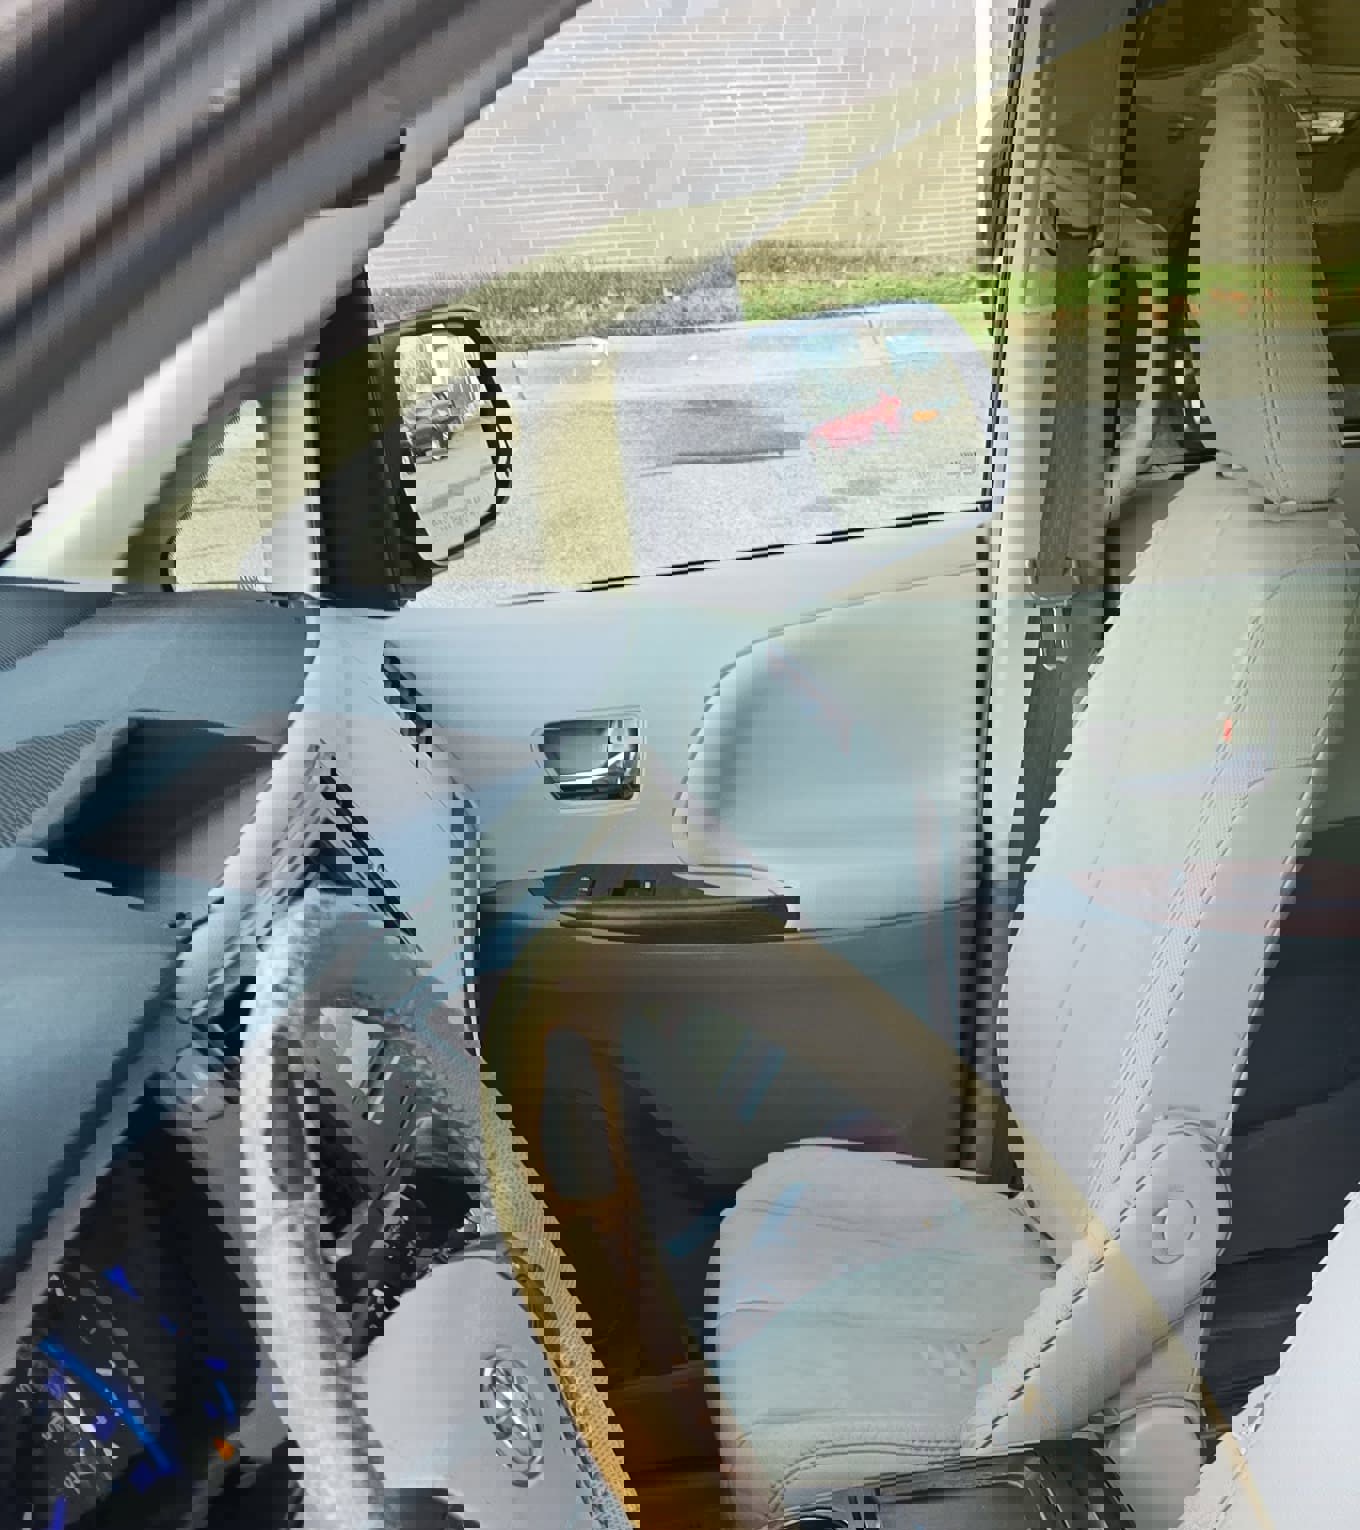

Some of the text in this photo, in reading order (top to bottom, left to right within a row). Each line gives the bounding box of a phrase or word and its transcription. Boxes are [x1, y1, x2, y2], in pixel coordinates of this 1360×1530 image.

[45, 1373, 68, 1400] 90
[90, 1411, 117, 1443] 100
[129, 1462, 155, 1494] 110
